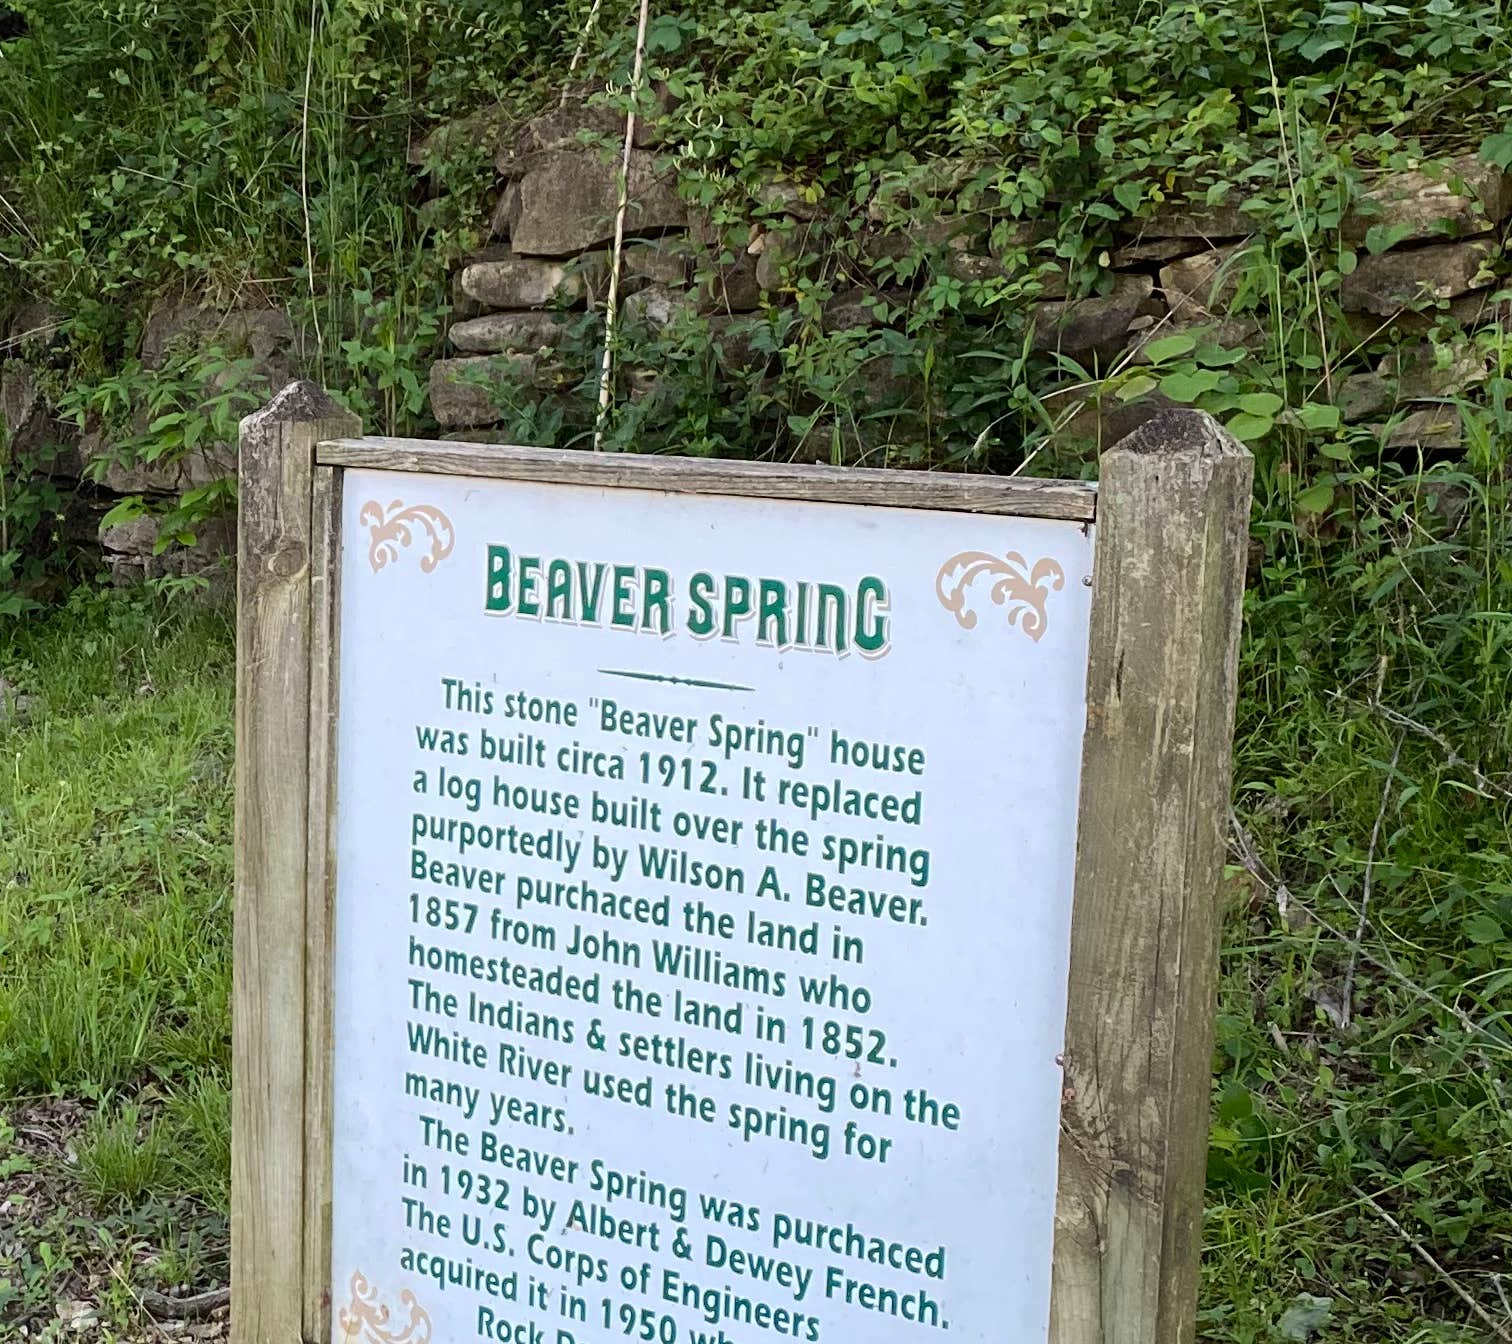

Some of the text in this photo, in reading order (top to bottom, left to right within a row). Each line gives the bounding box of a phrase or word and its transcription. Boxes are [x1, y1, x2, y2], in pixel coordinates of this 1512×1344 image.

[485, 544, 887, 653] BEAVER SPRING
[417, 727, 922, 826] was built circa 1912. It replaced
[442, 678, 925, 776] This stone "Beaver Spring" house
[411, 813, 927, 927] purportedly by Wilson A. Beaver.
[413, 766, 930, 888] a log house built over the spring
[411, 848, 864, 962] Beaver purchaced the land in
[412, 894, 872, 1014] 1857 from John Williams who
[407, 979, 961, 1131] The Indians & settlers living on the
[408, 934, 898, 1068] homesteaded the land in 1852.
[405, 1072, 576, 1136] many years.
[407, 1022, 893, 1164] White River used the spring for
[403, 1153, 949, 1330] in 1932 by Albert & Dewey French.
[419, 1114, 946, 1280] The Beaver Spring was purchaced
[400, 1247, 518, 1302] acquired
[528, 1275, 549, 1312] it
[560, 1284, 587, 1323] in
[402, 1198, 820, 1342] The U.S. Corps of Engineers
